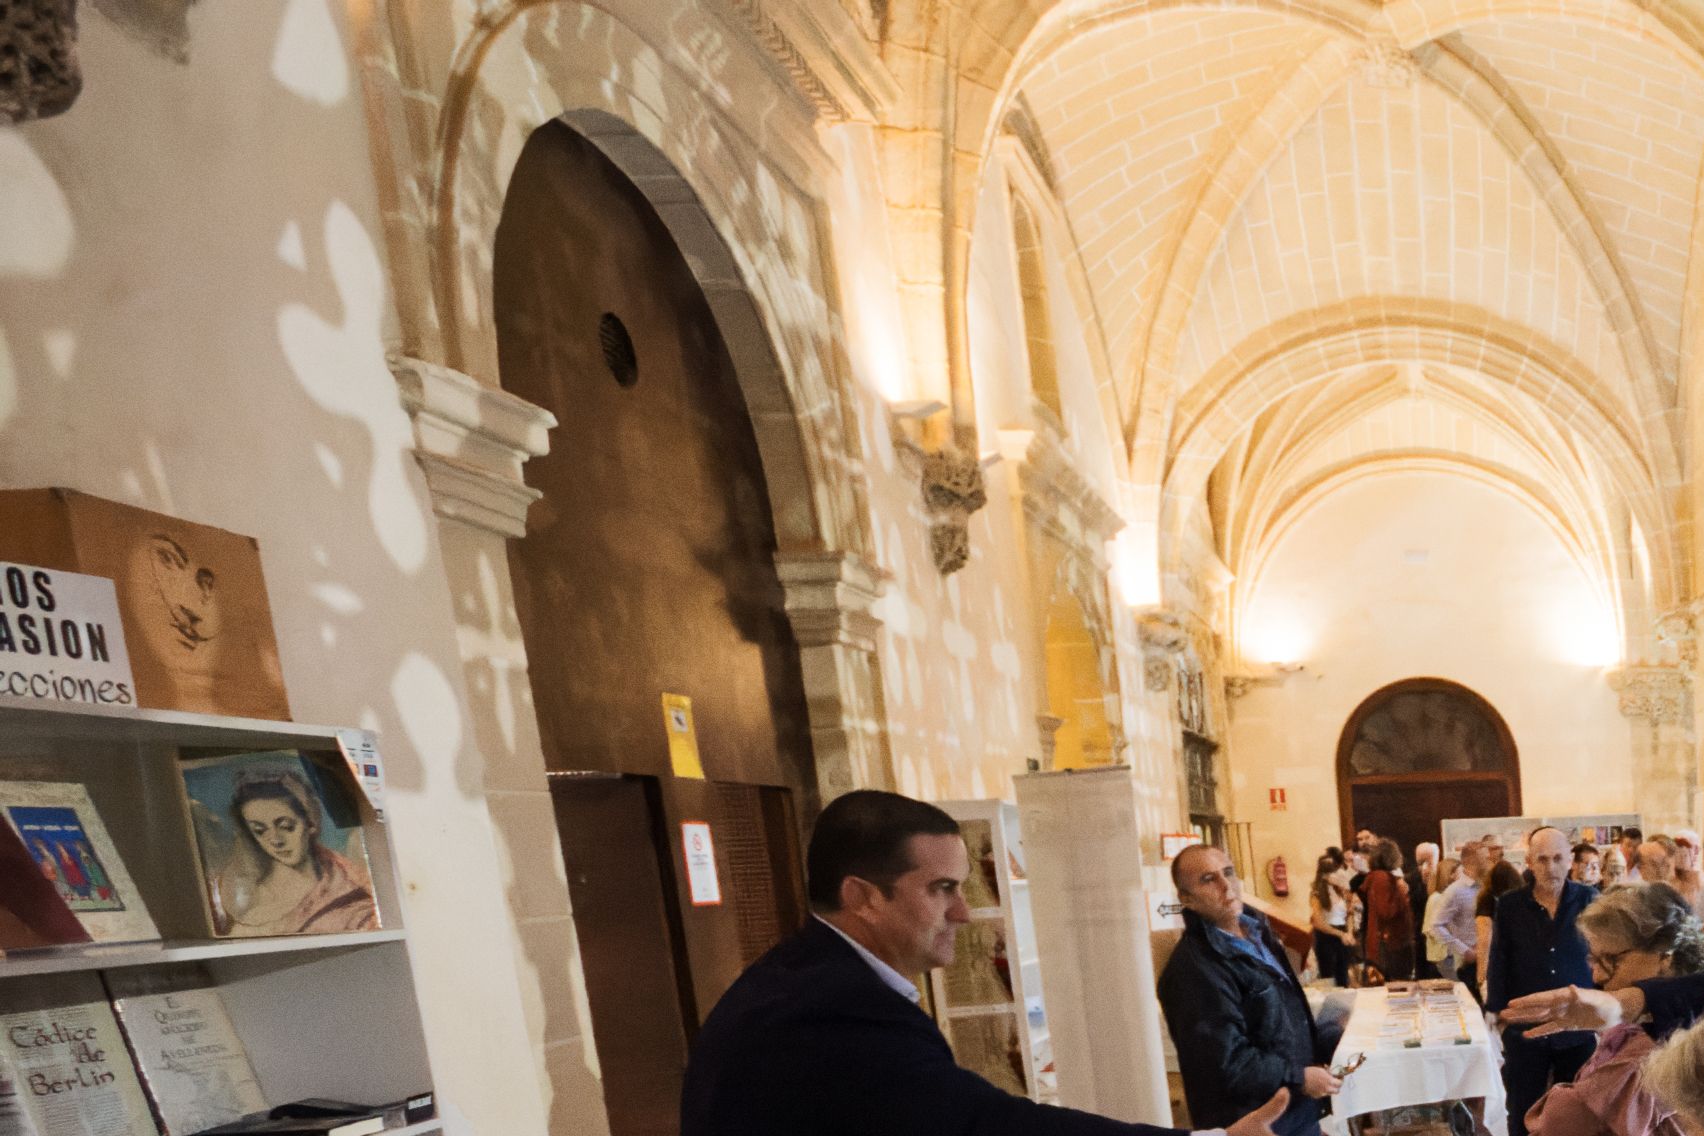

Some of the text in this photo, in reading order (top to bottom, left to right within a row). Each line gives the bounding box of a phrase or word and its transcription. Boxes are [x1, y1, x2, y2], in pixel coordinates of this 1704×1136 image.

[0, 567, 56, 612] OS
[77, 1042, 106, 1063] de
[28, 1067, 115, 1096] Berlin
